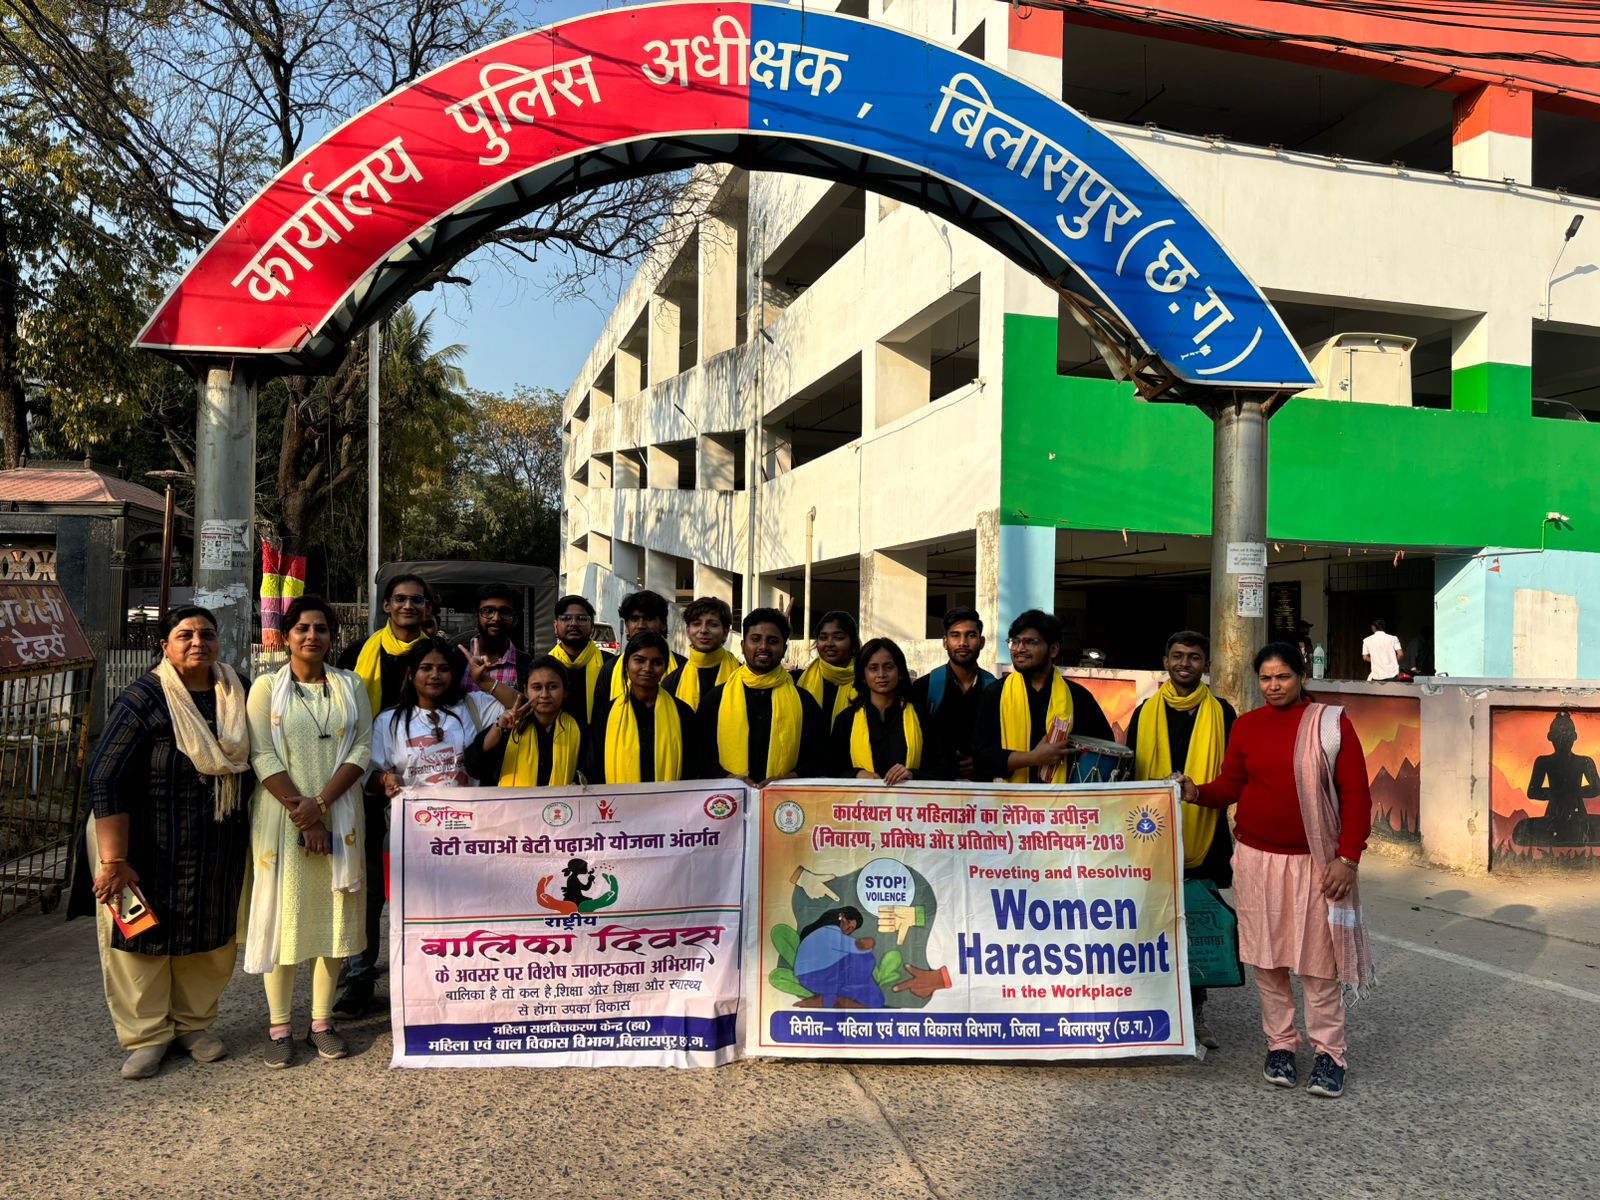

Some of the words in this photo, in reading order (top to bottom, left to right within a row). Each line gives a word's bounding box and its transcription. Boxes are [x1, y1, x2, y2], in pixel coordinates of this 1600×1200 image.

[231, 136, 424, 303] कार्यालय
[445, 56, 601, 167] पुलिस
[930, 72, 1143, 242] बिलासपुर
[12, 624, 66, 665] ट्रेडर्स
[832, 801, 892, 822] कार्यस्थल
[896, 806, 914, 823] पर
[917, 803, 976, 825] महिलाओं
[980, 807, 1000, 825] का
[1003, 804, 1045, 825] लैंगिक
[1050, 806, 1099, 829] उत्पीड़न
[430, 837, 461, 855] बेटी
[521, 835, 551, 853] बेटी
[554, 832, 605, 856] पढ़ाओ
[608, 831, 665, 850] योजना
[670, 827, 720, 847] अंतर्गत
[881, 828, 925, 850] प्रतिषेध
[930, 830, 954, 850] और
[958, 830, 1013, 854] प्रतितोष)
[1018, 831, 1124, 852] अधिनियम-2013
[865, 876, 907, 889] STOP!
[970, 865, 1040, 883] Preveting
[1044, 866, 1073, 880] and
[1077, 865, 1152, 881] Resolving
[865, 892, 906, 902] VOILENCE
[991, 888, 1136, 931] Women
[545, 912, 597, 931] राष्ट्रीय
[421, 930, 577, 960] बालिका
[588, 925, 727, 964] दिवस
[958, 932, 1170, 976] Harassment
[435, 965, 449, 983] के
[455, 968, 499, 982] अवसर
[503, 967, 523, 981] पर
[528, 962, 567, 980] विशेष
[650, 955, 705, 974] अभियान
[446, 985, 485, 1001] बालिका
[490, 985, 498, 1002] है
[502, 985, 514, 999] तो
[519, 987, 540, 999] कल
[544, 984, 552, 1000] है
[588, 981, 609, 996] और
[613, 980, 640, 994] शिक्षा
[645, 977, 665, 991] और
[669, 978, 703, 991] स्वास्थ्य
[1002, 984, 1016, 998] in
[1020, 984, 1048, 998] the
[1051, 984, 1133, 1001] Workplace
[517, 1003, 529, 1015] से
[533, 1002, 557, 1015] होगा
[596, 999, 631, 1013] विकास
[493, 1024, 526, 1036] महिला
[600, 1020, 623, 1032] केन्द्र
[626, 1020, 651, 1032] (हब)
[837, 1016, 873, 1038] महिला
[877, 1017, 893, 1039] एवं
[897, 1020, 920, 1038] बाल
[923, 1016, 962, 1038] विकास
[965, 1016, 1006, 1040] विभाग,
[1009, 1015, 1040, 1038] जिला
[1058, 1017, 1110, 1042] बिलासपुर
[1114, 1015, 1154, 1041] (छ.ग.)
[428, 1037, 469, 1052] महिला
[473, 1036, 492, 1051] एवं
[496, 1038, 522, 1051] बाल
[526, 1035, 569, 1050] विकास
